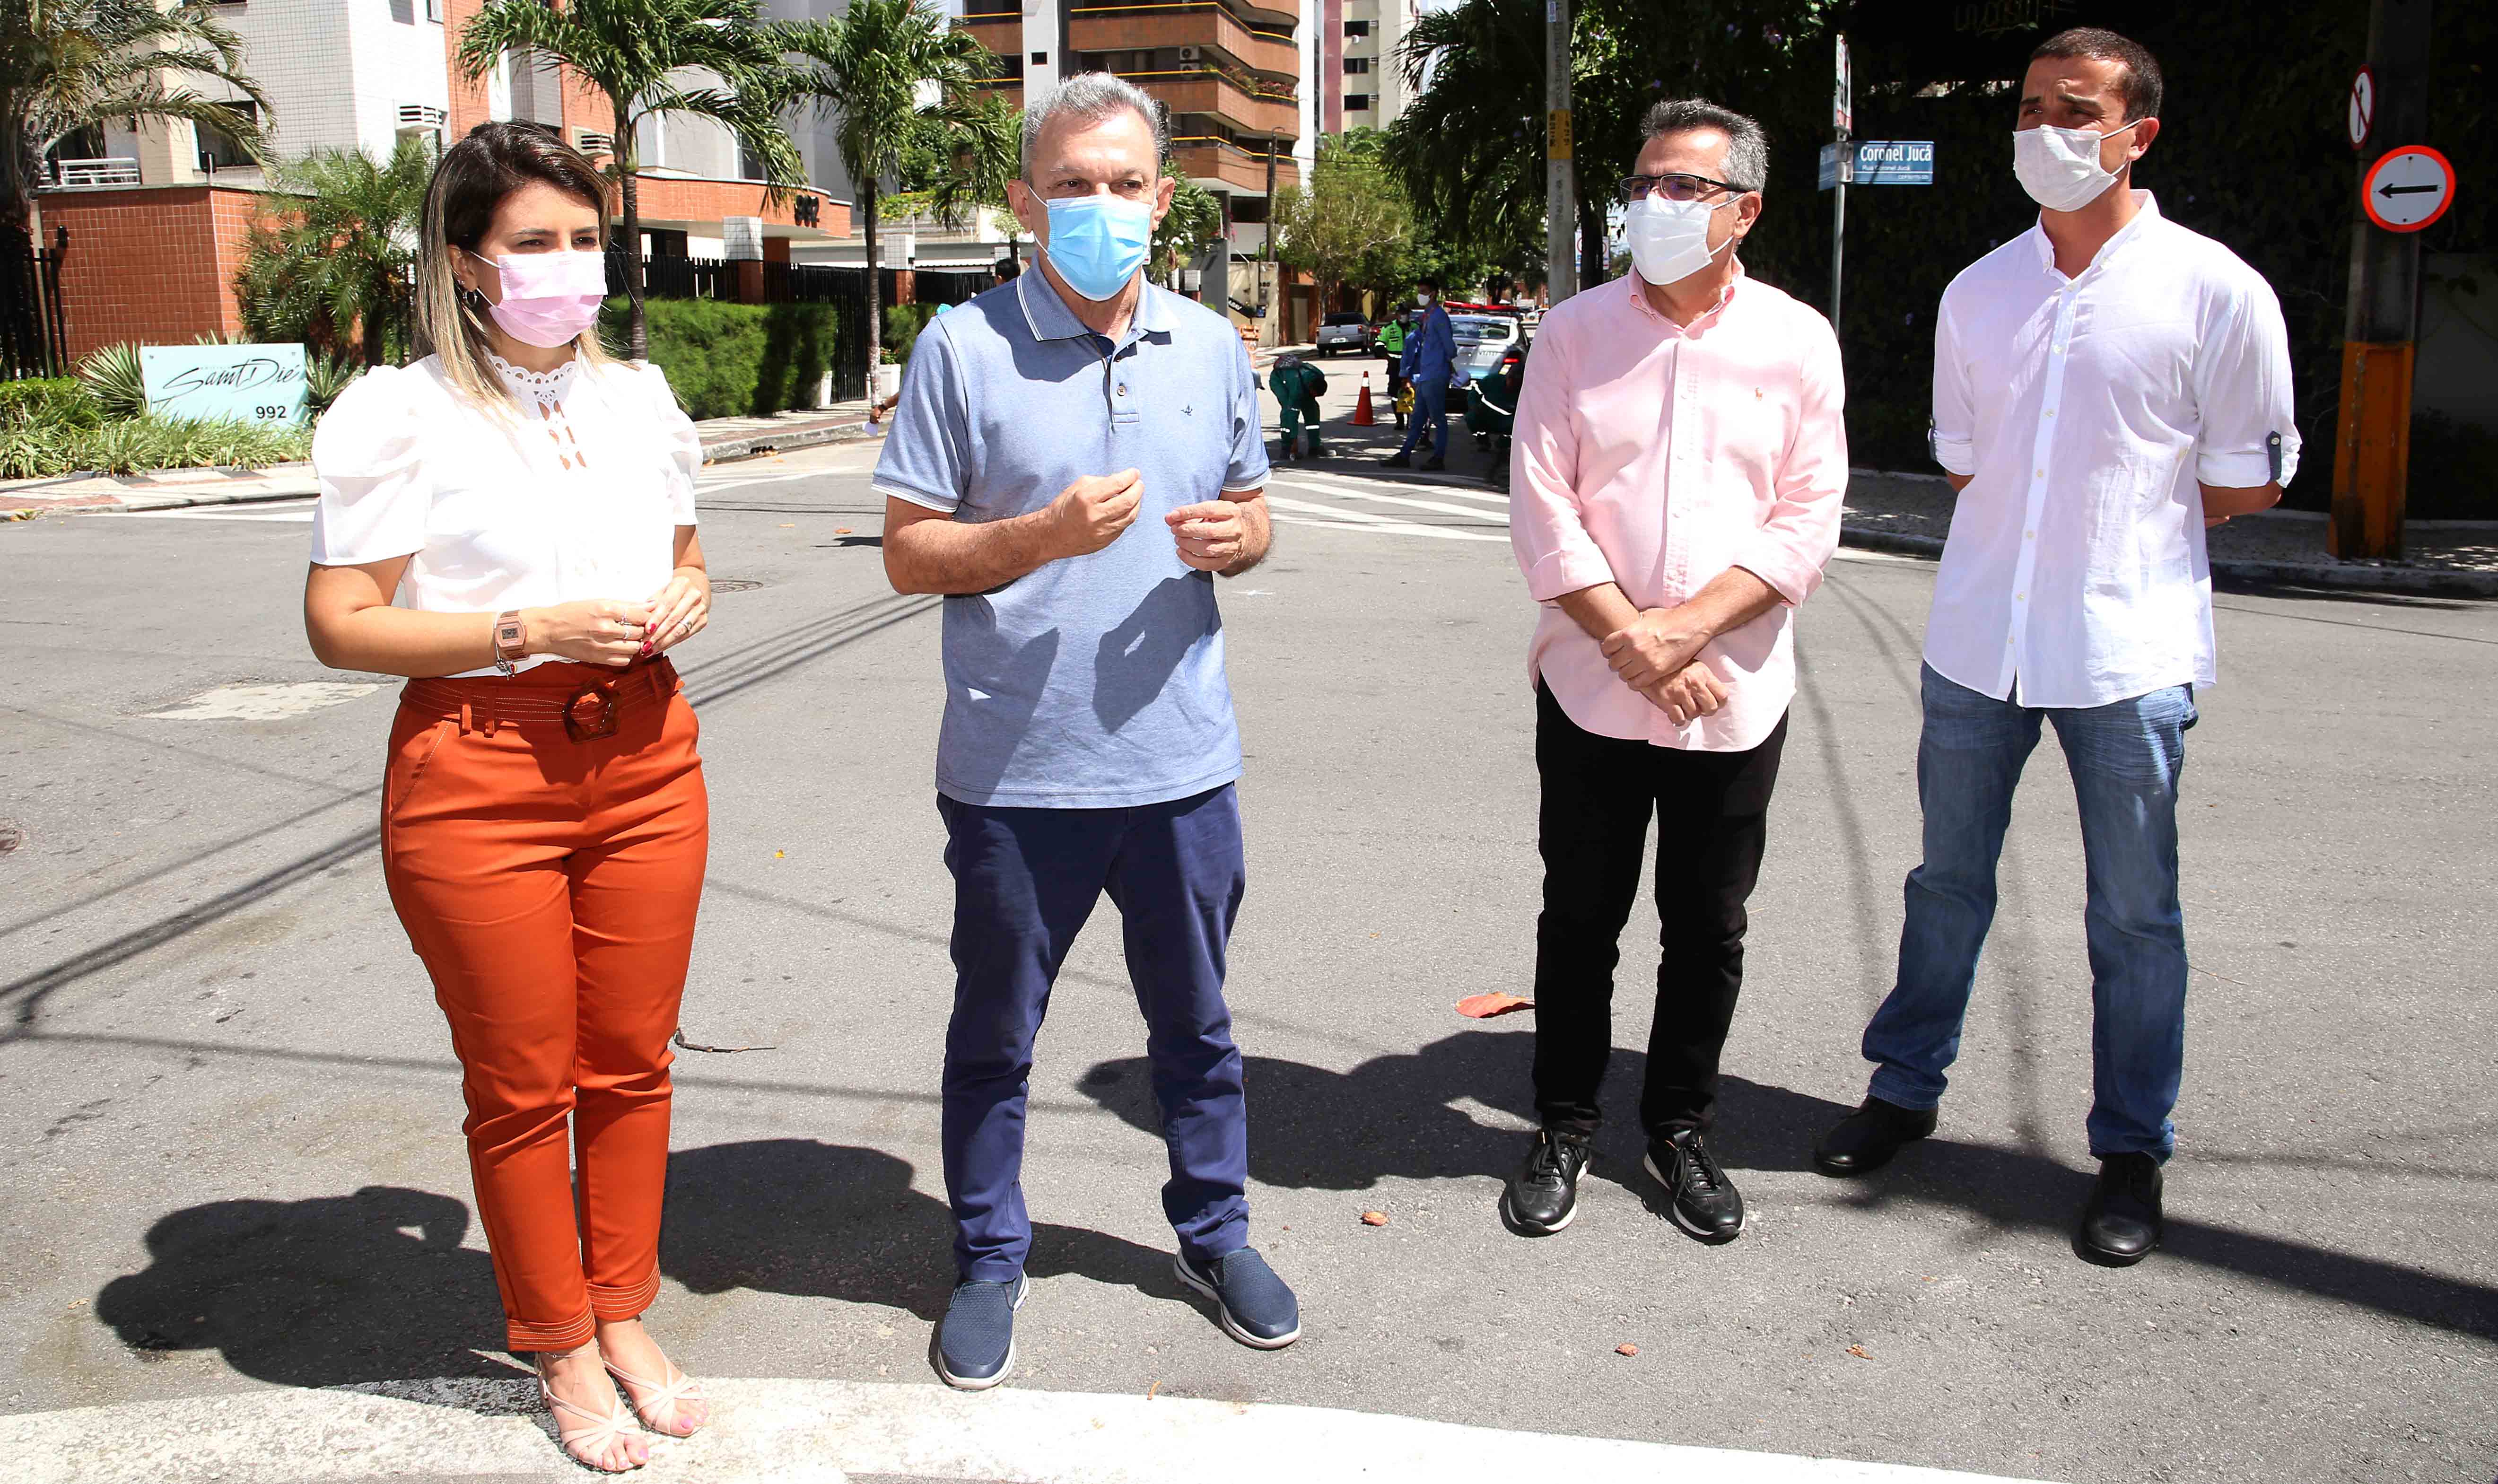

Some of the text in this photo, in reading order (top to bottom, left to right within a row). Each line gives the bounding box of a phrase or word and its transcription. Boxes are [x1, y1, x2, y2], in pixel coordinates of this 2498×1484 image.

[1860, 144, 1931, 162] Coronel Jucá
[256, 406, 287, 419] 992
